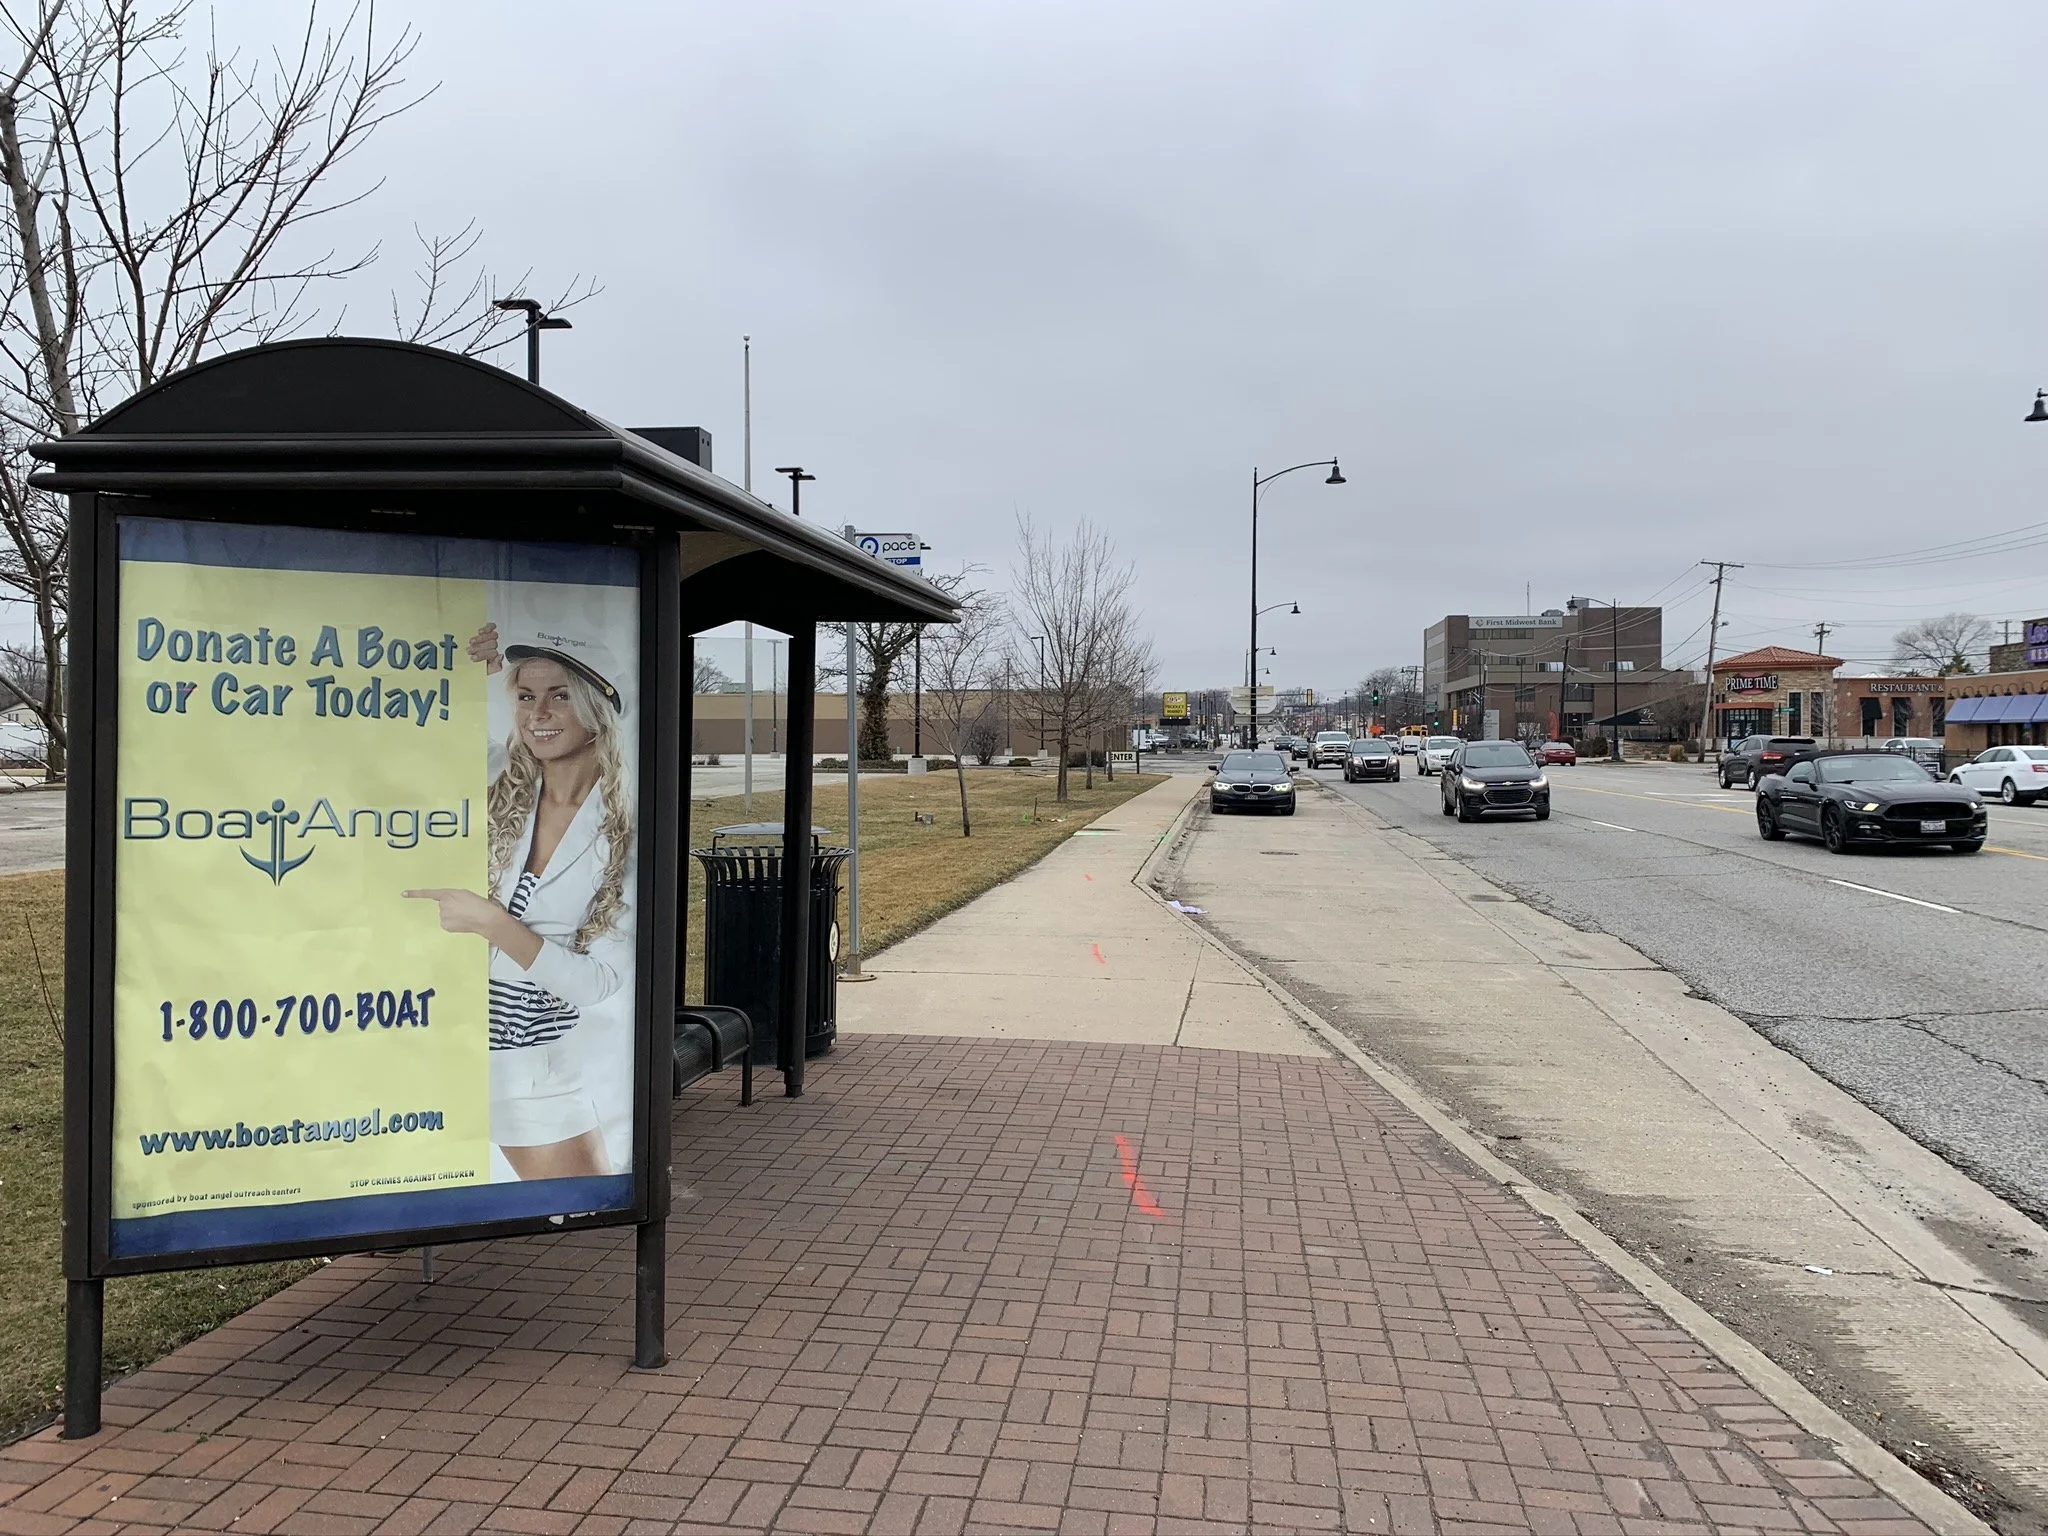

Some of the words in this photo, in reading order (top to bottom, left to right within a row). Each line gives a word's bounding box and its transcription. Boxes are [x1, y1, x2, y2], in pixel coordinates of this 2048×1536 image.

[882, 541, 916, 553] pace
[1538, 618, 1557, 626] Bank
[136, 616, 296, 667] Donate
[310, 625, 343, 668] A
[357, 626, 458, 671] Boat
[1725, 677, 1754, 691] PRIME
[1754, 675, 1777, 690] TIME
[1870, 683, 1936, 692] RESTAURANT
[1937, 684, 1944, 692] &
[146, 680, 197, 715] or
[211, 671, 293, 716] Car
[305, 675, 451, 727] Today!
[159, 987, 436, 1042] 1-800-700-BOAT
[139, 1107, 445, 1156] www.boatangel.com
[350, 1179, 369, 1188] STOP
[371, 1176, 401, 1186] CRIMES
[403, 1173, 436, 1183] AGAINST
[438, 1170, 475, 1180] CHILDREN
[132, 1196, 175, 1210] sponsored
[177, 1193, 188, 1203] by
[189, 1193, 208, 1201] boat
[210, 1191, 232, 1200] angel
[234, 1189, 270, 1198] outreach
[272, 1187, 301, 1196] centers
